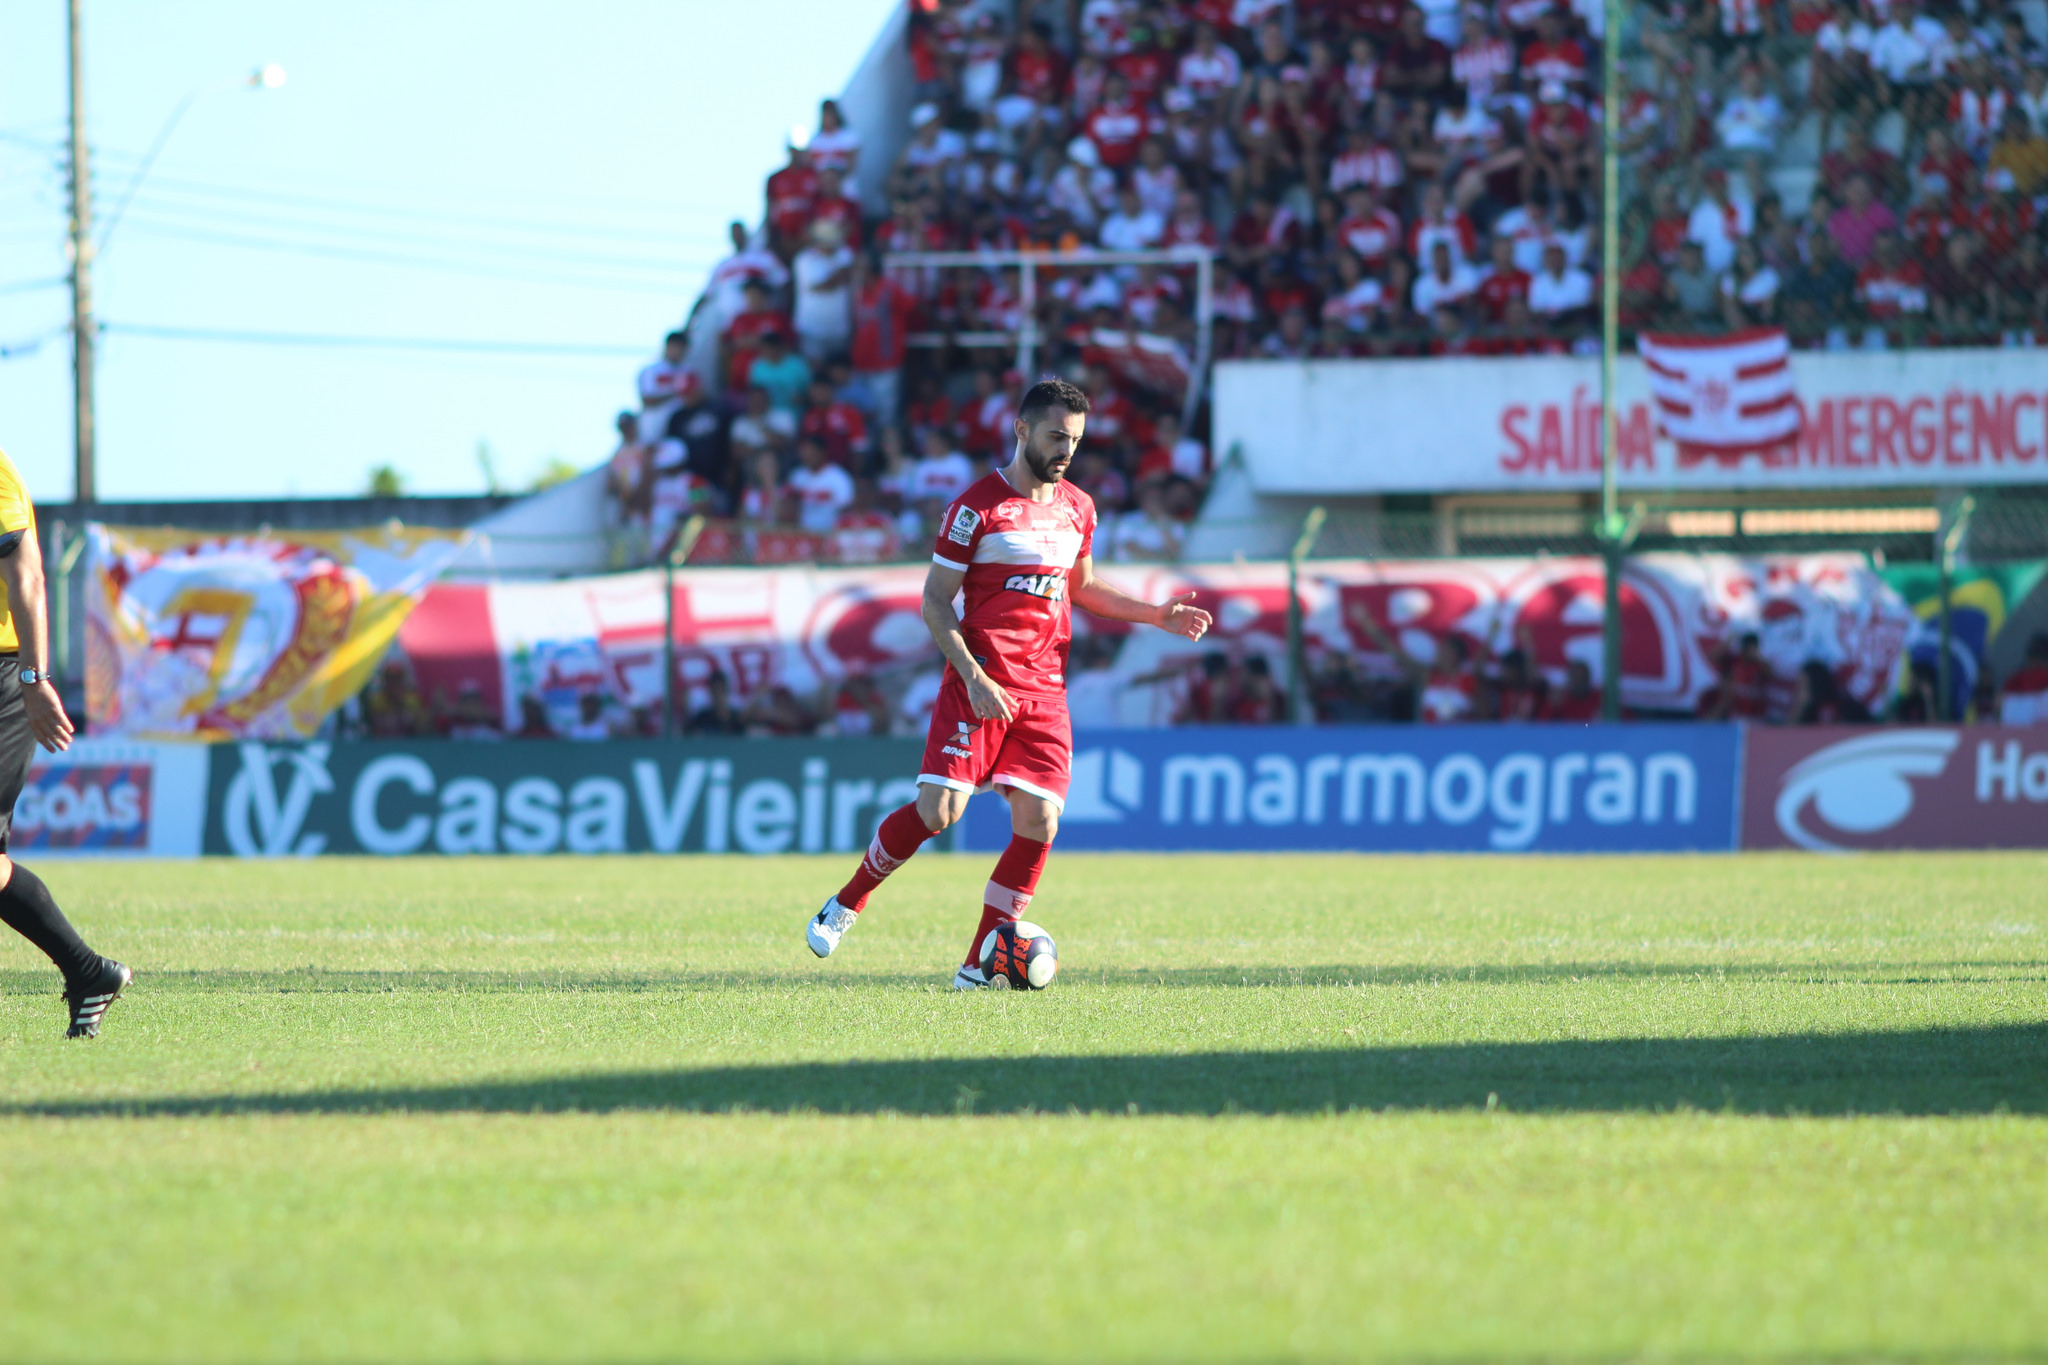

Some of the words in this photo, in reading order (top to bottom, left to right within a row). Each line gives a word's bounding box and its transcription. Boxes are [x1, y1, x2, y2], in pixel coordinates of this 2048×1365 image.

[1763, 382, 2048, 468] MERGÊNC
[942, 745, 972, 759] RINAT
[13, 781, 143, 832] GOAS
[1160, 751, 1698, 849] marmogran
